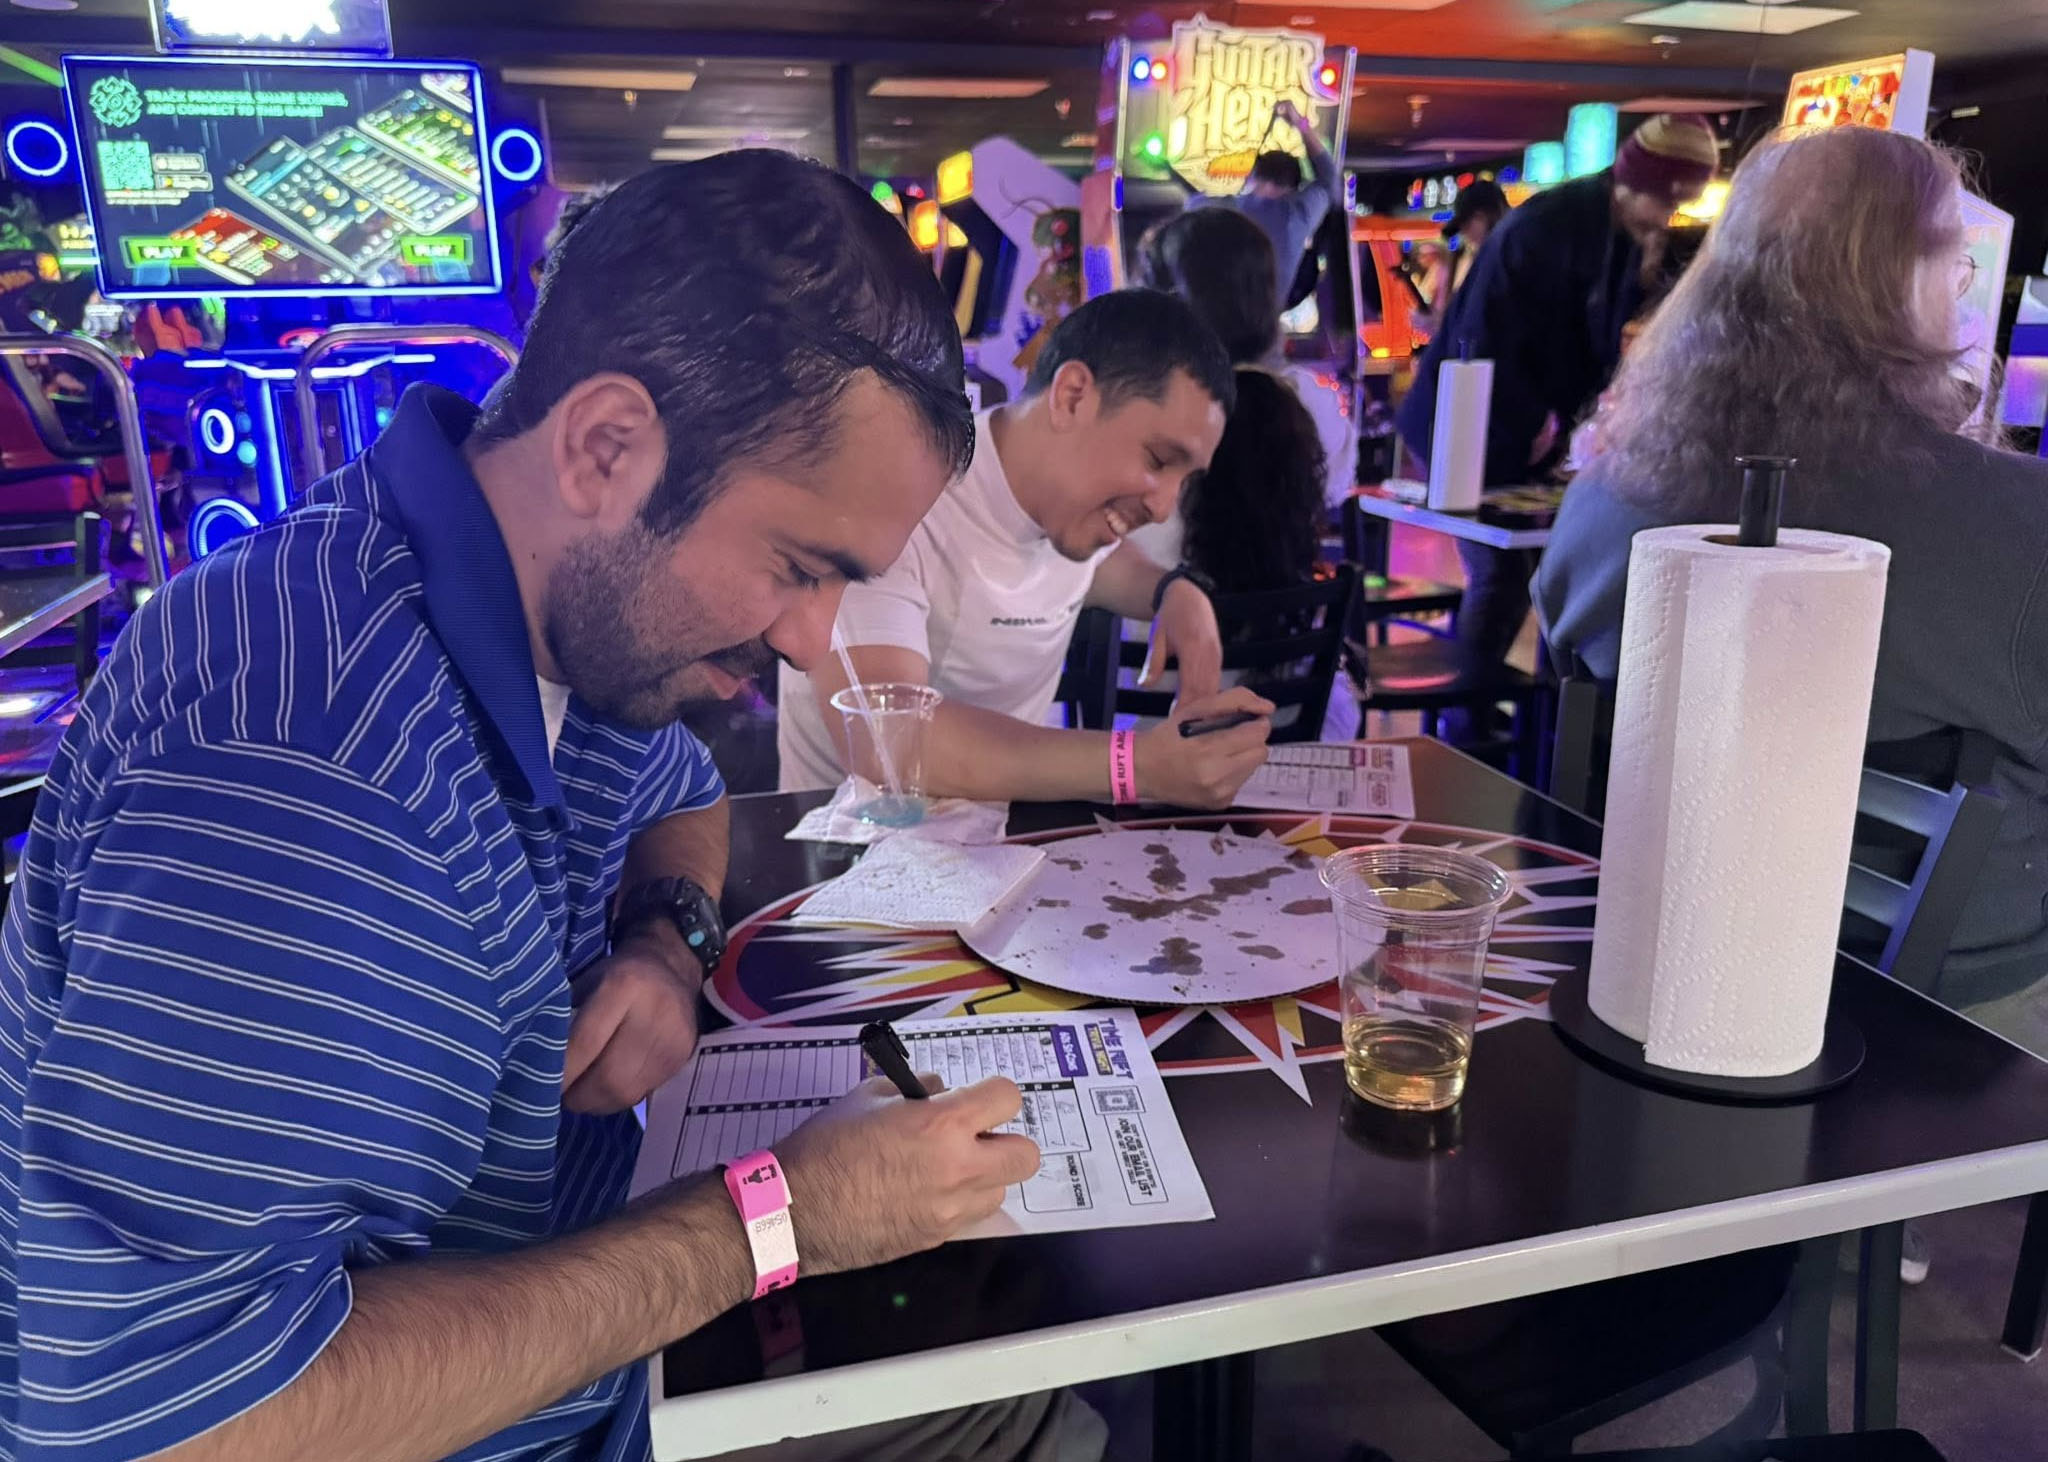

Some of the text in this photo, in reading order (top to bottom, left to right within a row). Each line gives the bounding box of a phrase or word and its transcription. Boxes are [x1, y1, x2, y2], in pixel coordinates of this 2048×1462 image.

[1174, 27, 1319, 94] GUITAR
[1099, 1017, 1123, 1049] TIME
[1066, 1154, 1079, 1177] ROUND
[1118, 1117, 1153, 1197] JOIN OUR EMAIL LIST
[1072, 1183, 1086, 1207] SCORE
